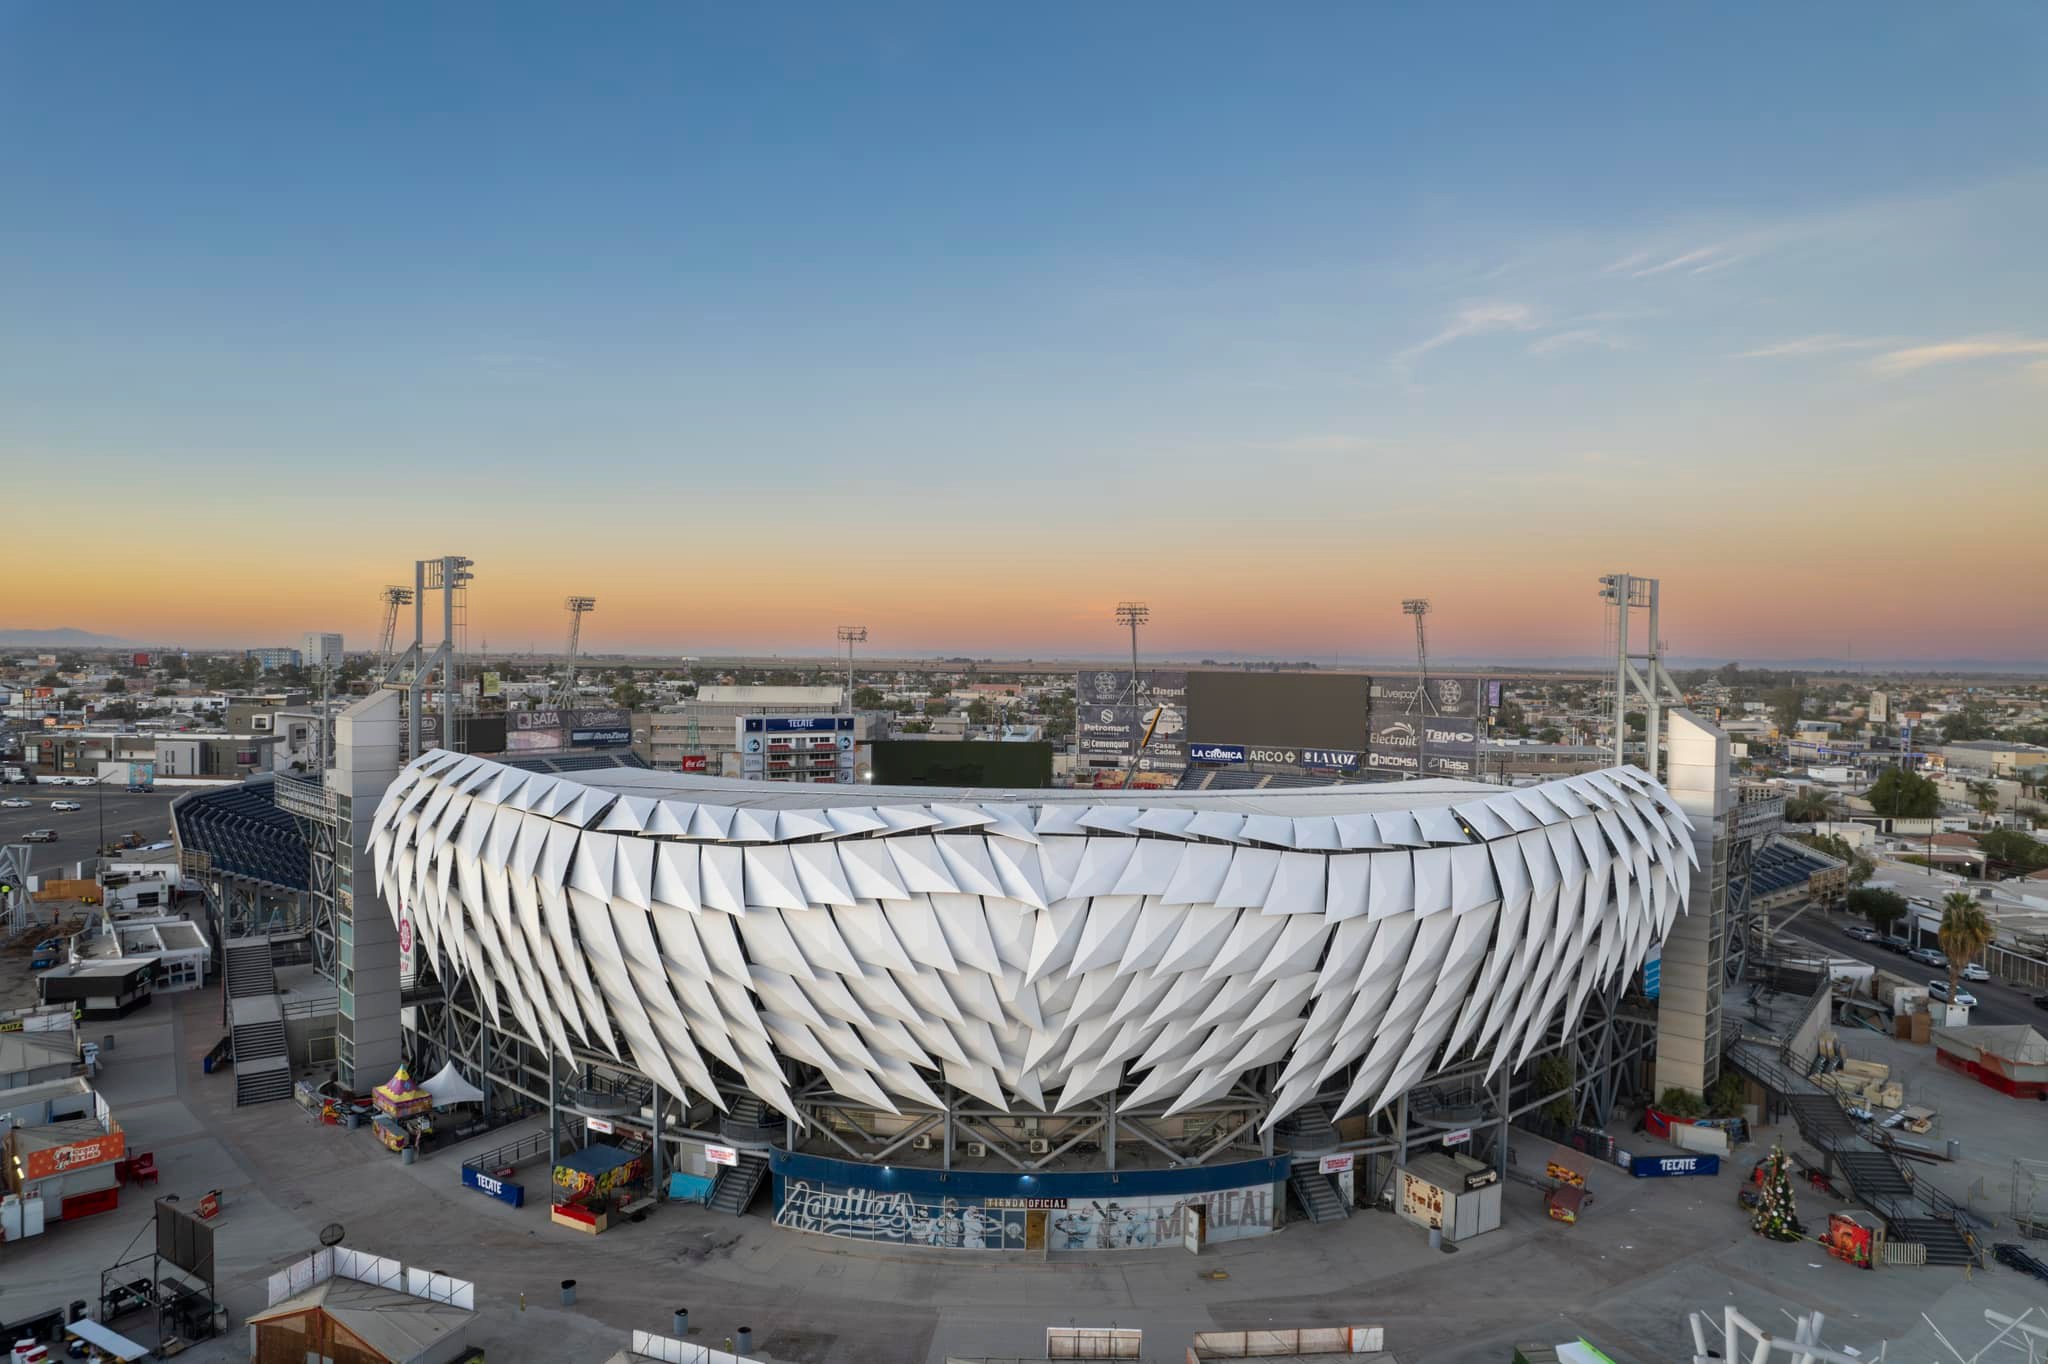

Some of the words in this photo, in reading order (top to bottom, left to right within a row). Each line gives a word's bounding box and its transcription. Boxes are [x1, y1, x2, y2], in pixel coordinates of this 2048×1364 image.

[532, 712, 560, 725] SATA
[788, 719, 814, 728] TECATE
[1425, 729, 1456, 742] TBM
[1191, 749, 1204, 758] LA
[1249, 750, 1283, 763] ARCO
[1659, 1158, 1697, 1172] TECATE
[475, 1172, 503, 1194] TECATE
[988, 1198, 1025, 1209] TIENDA
[1028, 1199, 1066, 1209] OFICIAL
